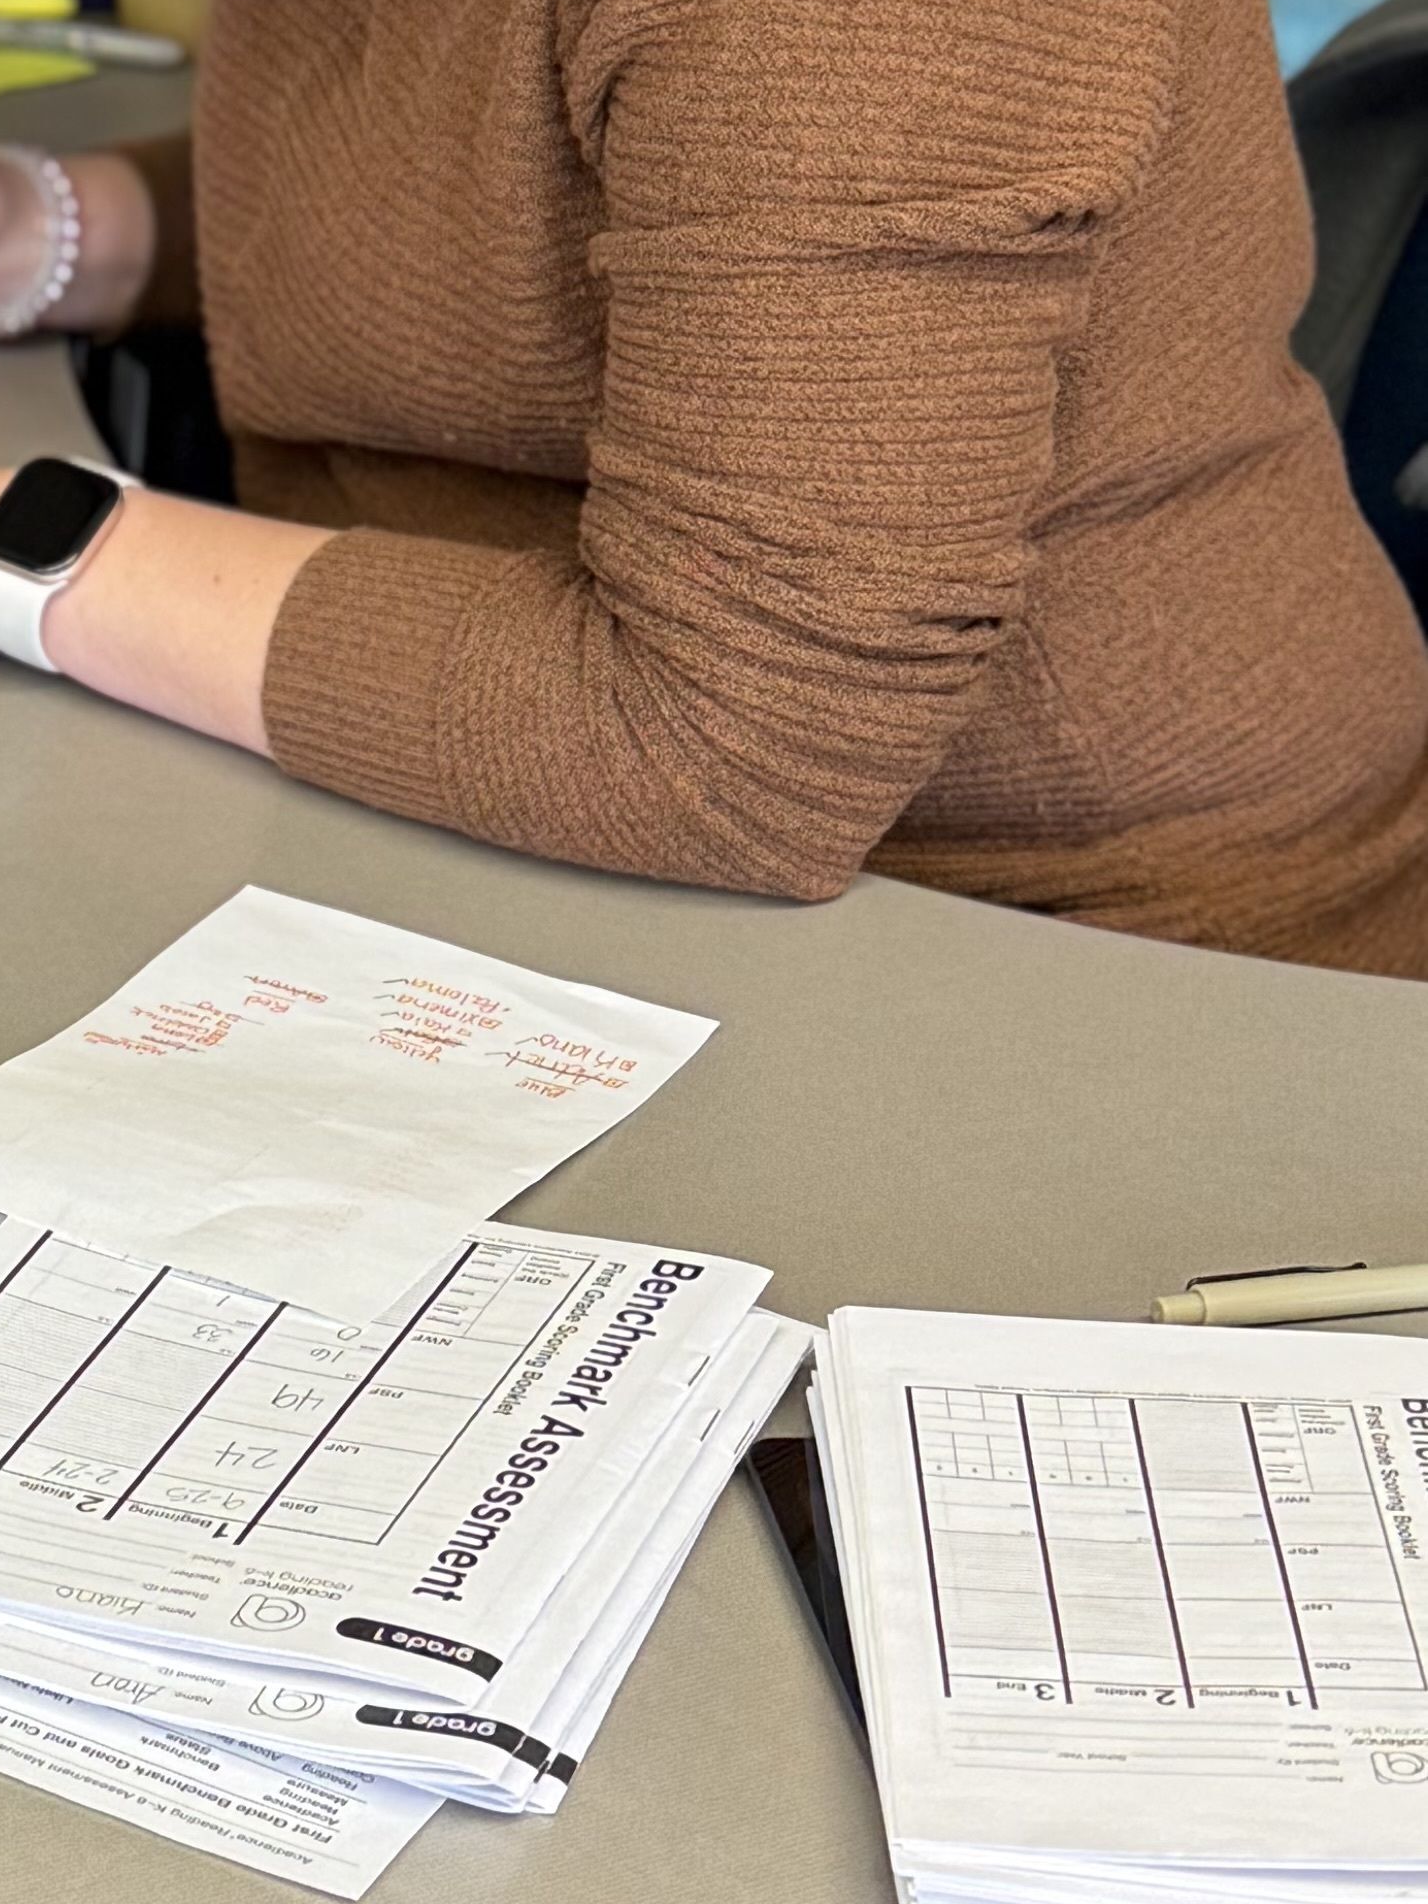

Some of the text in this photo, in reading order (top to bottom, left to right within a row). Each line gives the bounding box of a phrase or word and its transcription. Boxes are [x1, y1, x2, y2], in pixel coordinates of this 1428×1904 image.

[244, 996, 290, 1013] Red
[539, 1034, 618, 1070] Kiano
[513, 1275, 552, 1286] ORF
[591, 1262, 626, 1289] First
[565, 1289, 605, 1323] Grade
[192, 1323, 233, 1343] 33
[411, 1334, 453, 1346] NWF
[525, 1325, 578, 1368] Scoring
[550, 1258, 704, 1416] Benchmark
[271, 1383, 325, 1412] 49
[367, 1386, 405, 1399] PSF
[492, 1355, 546, 1417] Booklet
[1363, 1405, 1383, 1429] First
[214, 1441, 278, 1469] 24
[323, 1443, 361, 1455] LNF
[1371, 1433, 1395, 1466] Grade
[19, 1480, 104, 1513] 2 Middle
[1380, 1469, 1404, 1512] Scoring
[127, 1503, 230, 1539] 1 Beginning
[279, 1501, 318, 1514] Date
[411, 1414, 585, 1602] Assessment
[1392, 1515, 1420, 1560] Booklet
[56, 1586, 144, 1616] Kiano
[373, 1627, 476, 1664] grade 1
[1314, 1661, 1351, 1671] Date
[90, 1672, 166, 1705] Aron
[996, 1682, 1055, 1701] 3 End
[1094, 1687, 1176, 1706] 2 Middle
[1199, 1688, 1302, 1707] 1 Beginning
[10, 1719, 41, 1736] Cut
[393, 1710, 495, 1737] grade 1
[43, 1731, 78, 1750] and
[138, 1735, 221, 1772] Benchmark
[80, 1745, 130, 1770] Goals
[47, 1762, 135, 1800] Assessment
[132, 1766, 232, 1808] Benchmark
[286, 1779, 348, 1807] Measure
[262, 1794, 340, 1827] Acadience
[278, 1788, 339, 1815] Reading
[170, 1809, 230, 1837] Reading
[236, 1805, 288, 1830] Grade
[291, 1823, 334, 1844] First
